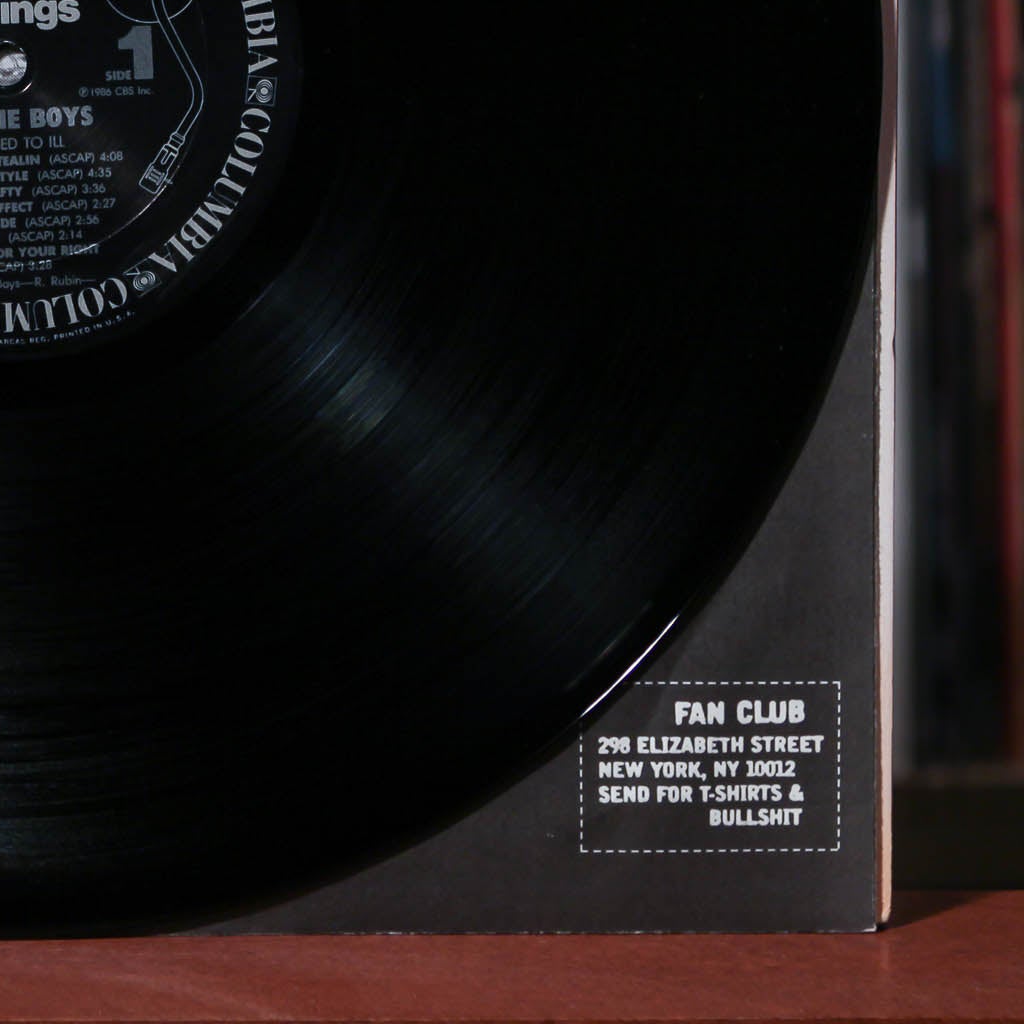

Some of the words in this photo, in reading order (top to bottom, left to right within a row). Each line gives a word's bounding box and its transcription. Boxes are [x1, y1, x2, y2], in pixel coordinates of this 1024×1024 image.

[118, 25, 154, 80] 1
[105, 70, 132, 81] SIDE
[115, 87, 134, 95] CBS
[29, 105, 94, 127] BOYS
[25, 137, 43, 149] TO
[48, 135, 64, 148] ILL
[49, 153, 95, 164] (ASCAP)
[99, 152, 123, 162] 4:08
[38, 169, 82, 181] (ASCAP)
[88, 168, 112, 178] 4:35
[32, 184, 77, 196] (ASCAP)
[82, 184, 106, 194] 3:36
[149, 108, 271, 272] COLUMBIA
[42, 200, 87, 211] (ASCAP)
[92, 198, 116, 209] 2:27
[25, 215, 71, 227] (ASCAP)
[76, 215, 99, 225] 2:56
[9, 230, 54, 242] (ASCAP)
[59, 229, 82, 240] 2:14
[18, 245, 56, 257] YOUR
[28, 259, 52, 270] 3:28
[674, 701, 725, 726] FAN
[736, 700, 805, 724] CLUB
[598, 737, 630, 754] 298
[637, 736, 744, 754] ELIZABETH
[750, 735, 824, 753] STREET
[598, 762, 644, 778] NEW
[650, 761, 707, 781] YORK,
[714, 761, 740, 778] NY
[746, 760, 796, 777] 10012
[598, 786, 650, 804] SEND
[656, 786, 693, 803] FOR
[700, 784, 782, 802] T-SHIRTS
[788, 784, 804, 802] &
[709, 808, 803, 826] BULLSHIT
